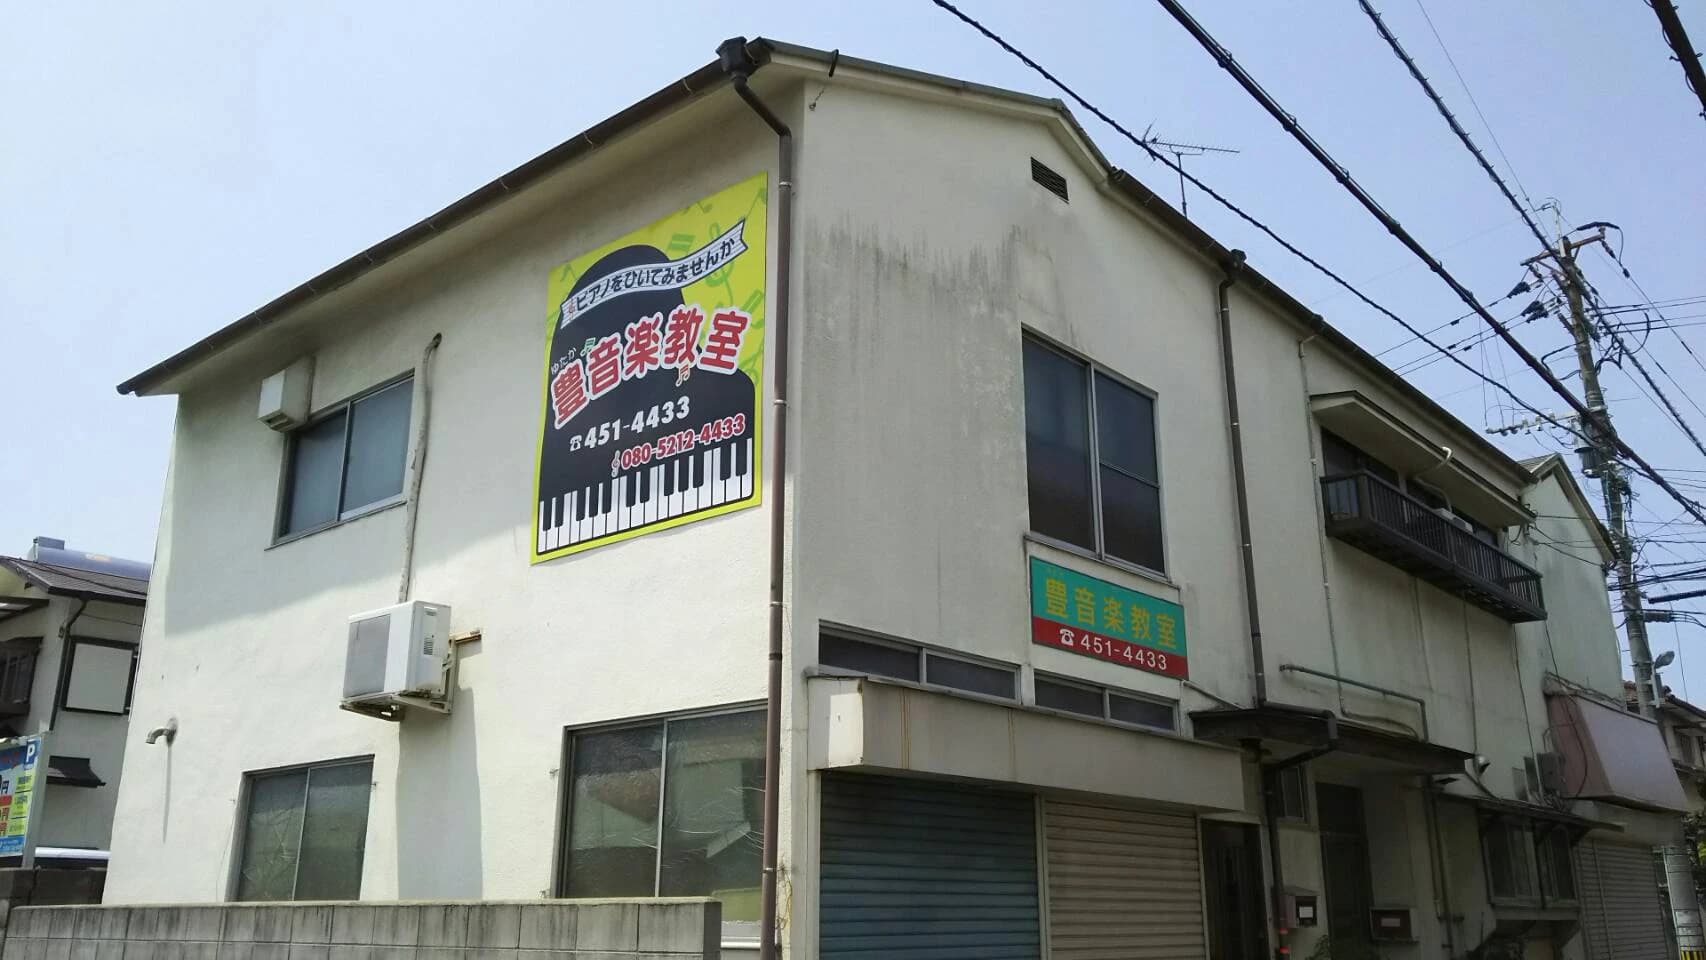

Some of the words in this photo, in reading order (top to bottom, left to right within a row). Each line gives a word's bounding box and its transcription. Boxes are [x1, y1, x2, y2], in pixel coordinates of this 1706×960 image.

[576, 238, 735, 309] ピアノをひいてみませんか
[551, 348, 577, 374] ゆたか
[553, 306, 748, 426] 豊音楽教室
[584, 396, 691, 450] 451-4433
[620, 413, 746, 471] 080-5212-4433
[1045, 577, 1177, 649] 豊音楽教室
[1081, 634, 1168, 671] 451-4433
[26, 743, 36, 763] P
